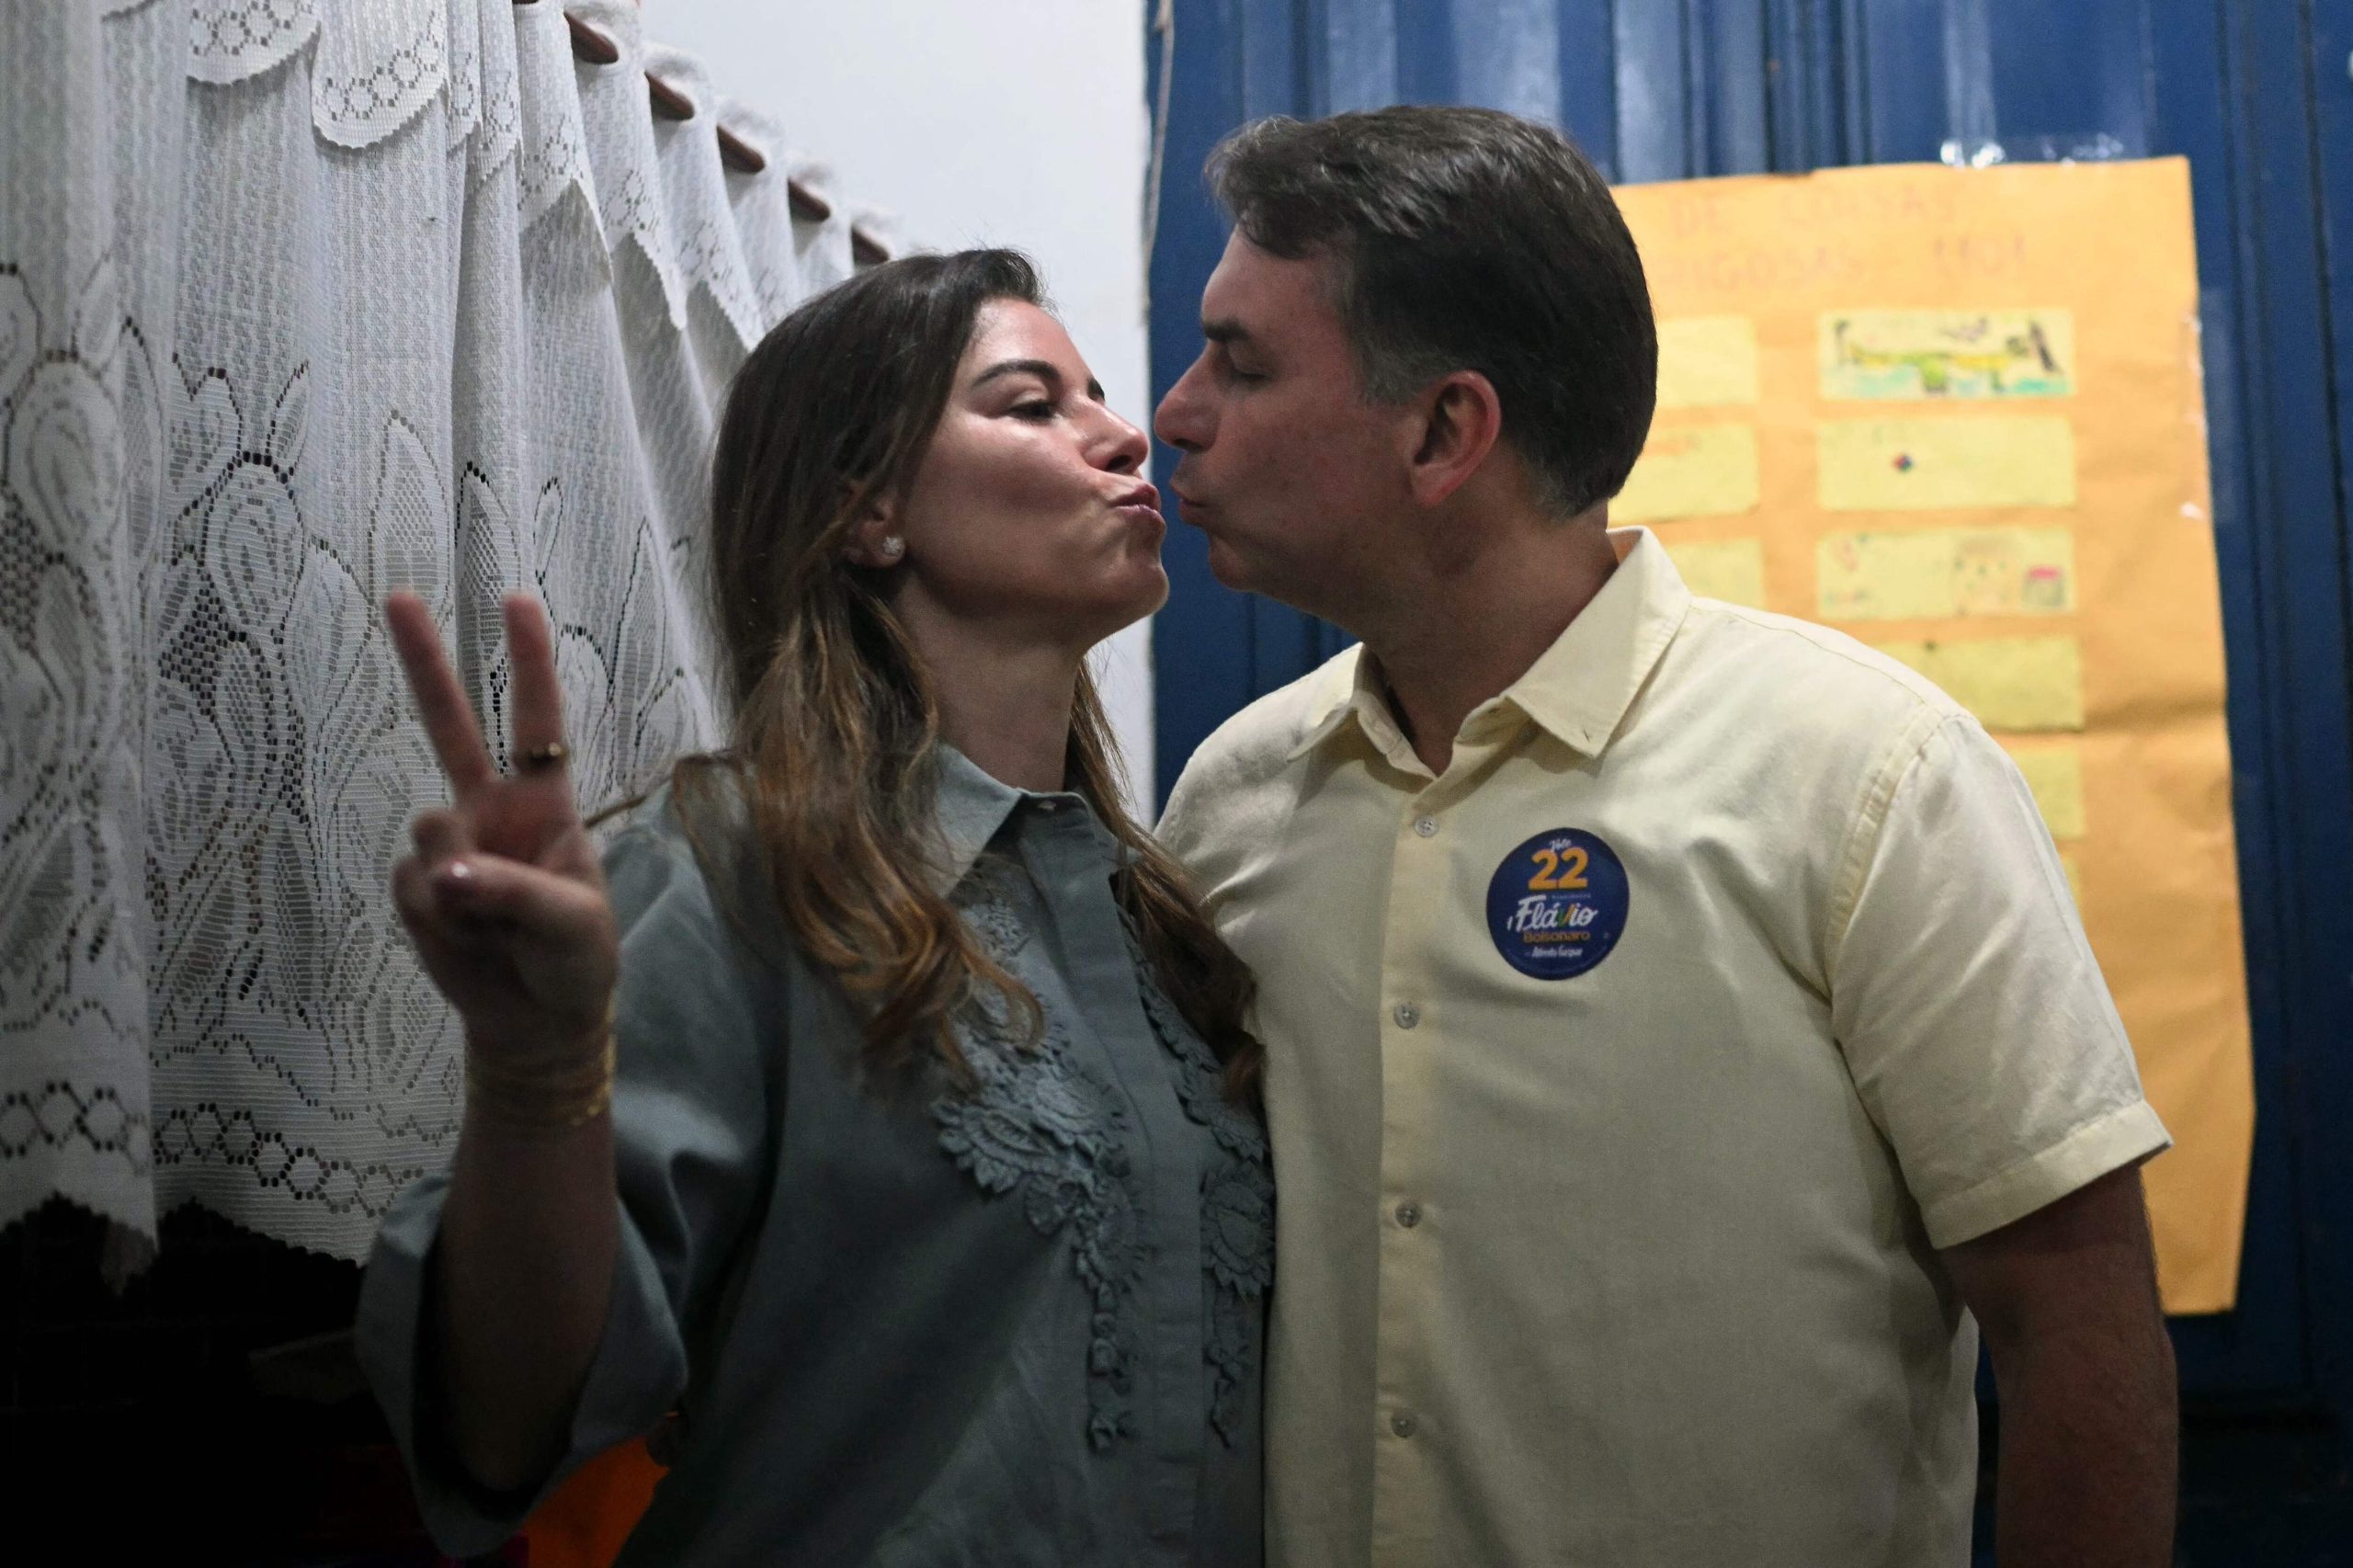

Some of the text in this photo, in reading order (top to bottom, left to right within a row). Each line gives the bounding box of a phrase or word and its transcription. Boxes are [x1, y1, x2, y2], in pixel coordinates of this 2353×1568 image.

[1529, 846, 1588, 890] 22
[1506, 894, 1598, 932] Flávio
[1523, 930, 1590, 943] Bolsonaro
